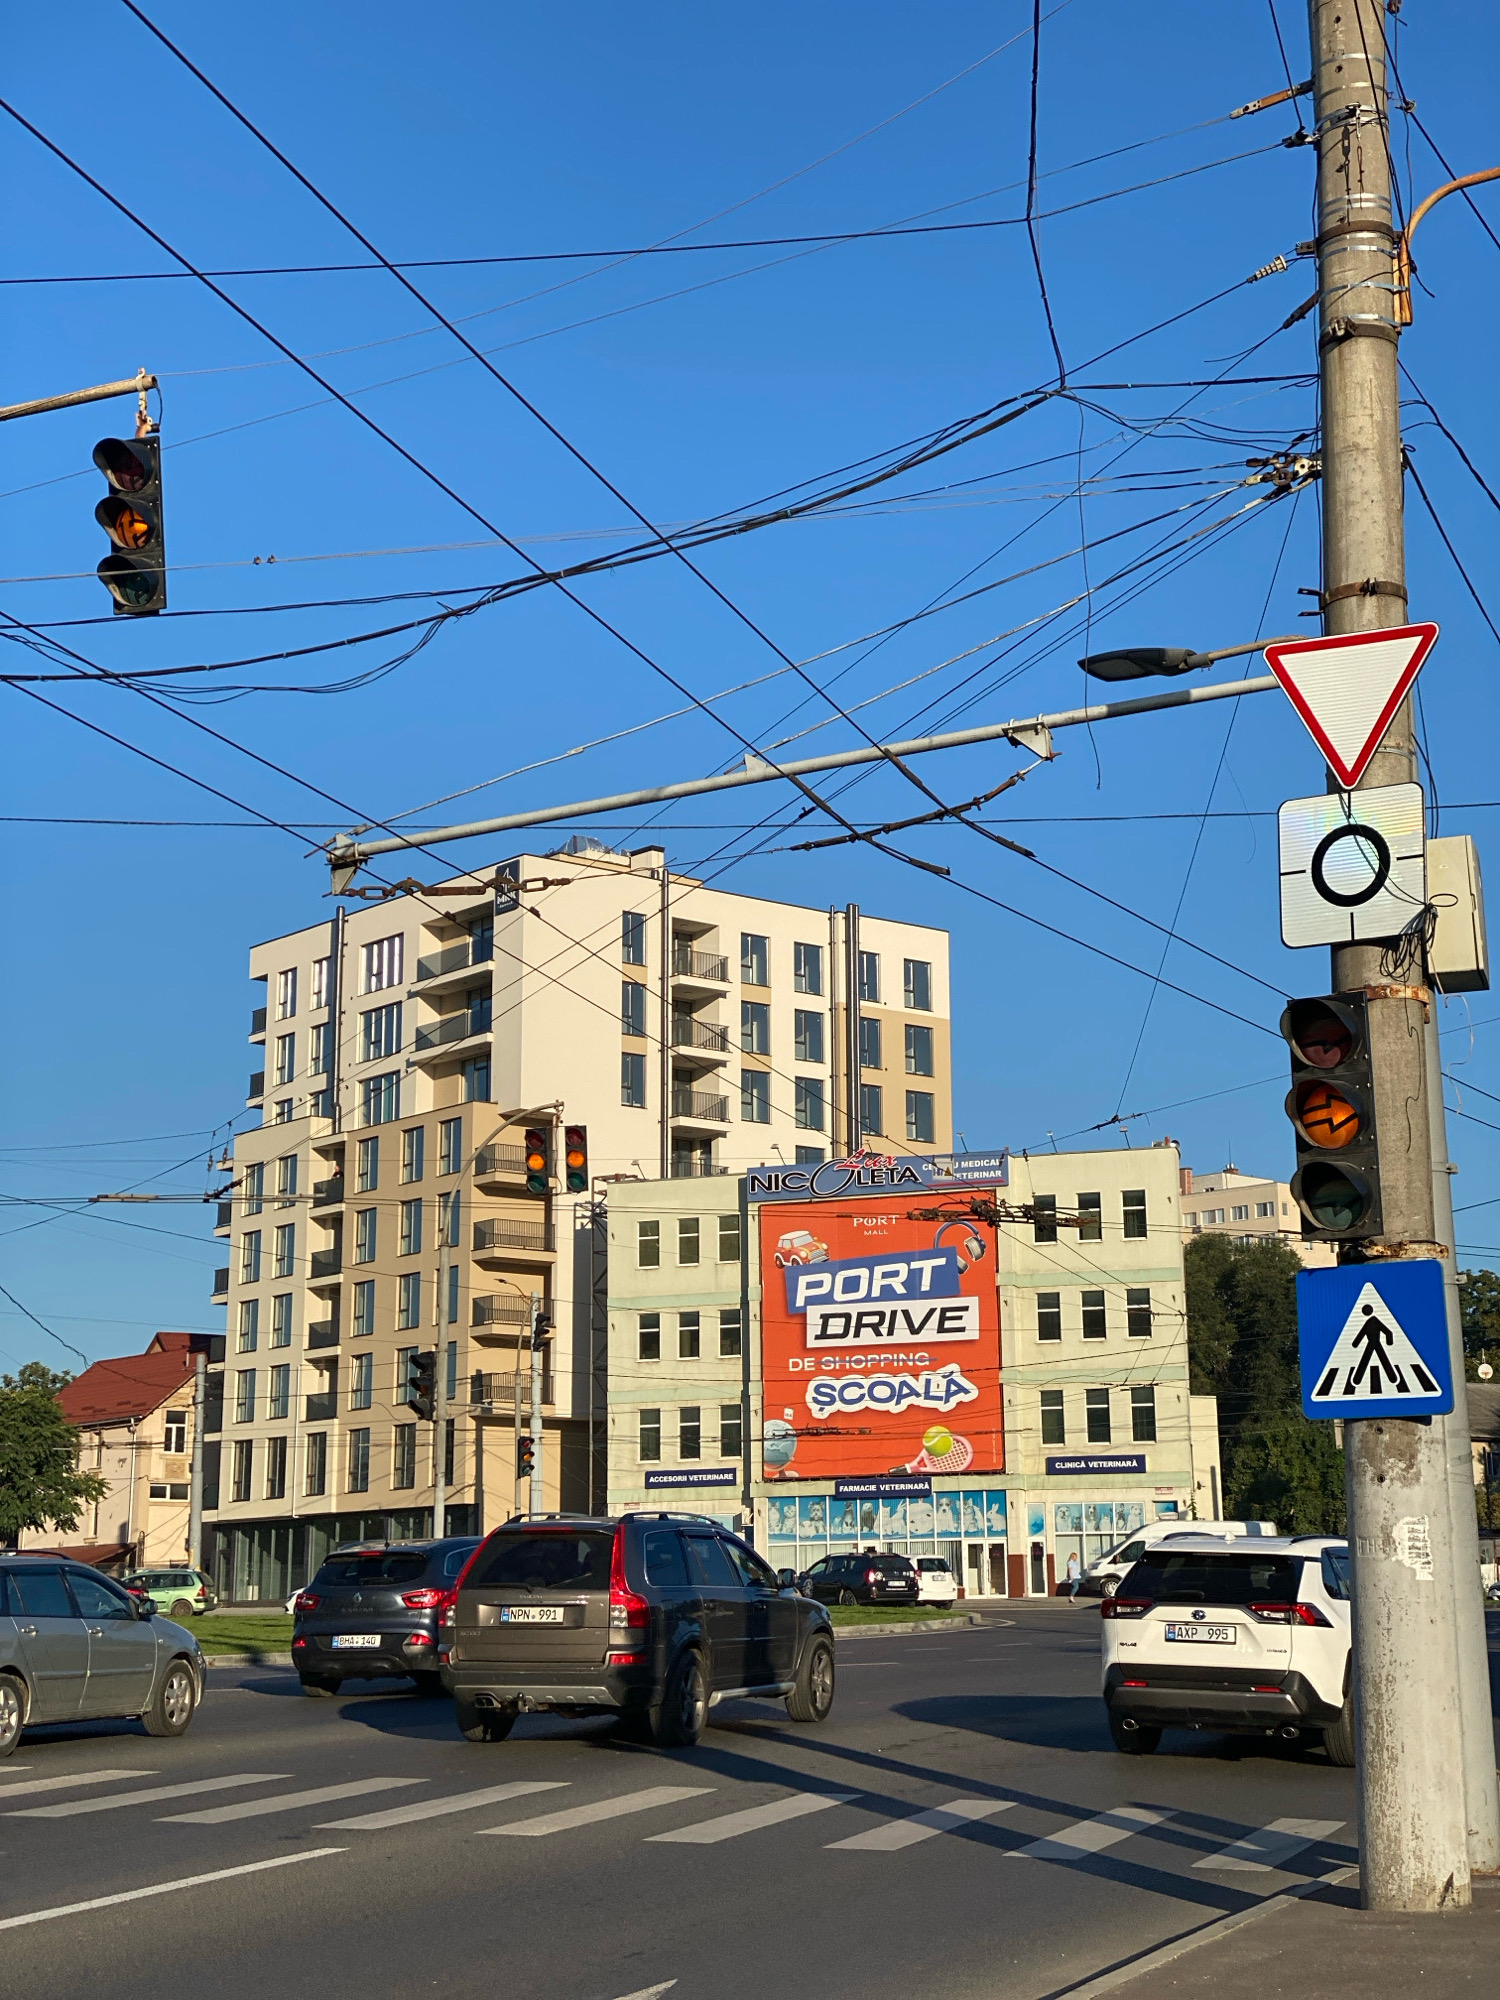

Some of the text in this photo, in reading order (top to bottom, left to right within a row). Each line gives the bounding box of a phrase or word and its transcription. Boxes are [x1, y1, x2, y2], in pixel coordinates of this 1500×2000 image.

[834, 1148, 898, 1171] Lux
[922, 1161, 958, 1171] CEU
[749, 1158, 922, 1197] NICOLETA
[853, 1215, 900, 1227] PORT
[795, 1257, 947, 1307] PORT
[814, 1305, 970, 1341] DRIVE
[789, 1352, 930, 1372] DE SHOPPING
[1055, 1459, 1138, 1469] CLINICĂ VETERINARĂ
[649, 1473, 734, 1483] ACCESORII VETERINARE
[839, 1482, 930, 1492] FARMACIE VETERINARĂ
[510, 1609, 530, 1620] NPN
[539, 1609, 557, 1620] 991
[1176, 1627, 1198, 1639] AXP
[1207, 1628, 1229, 1640] 995
